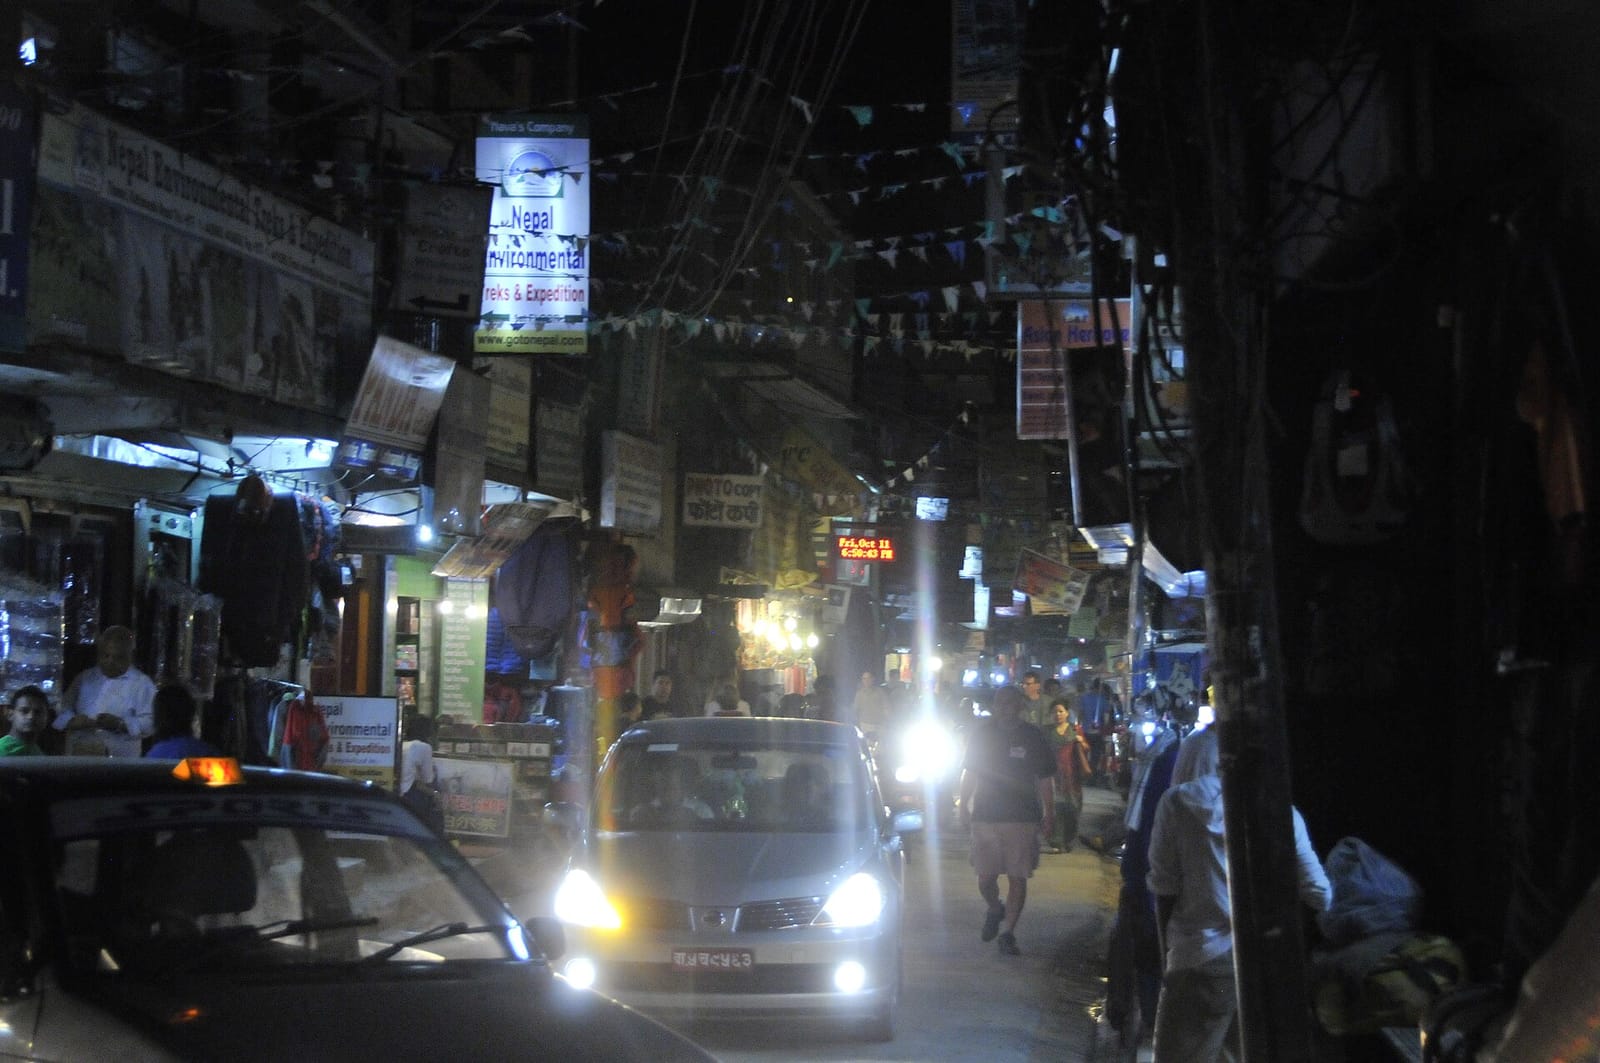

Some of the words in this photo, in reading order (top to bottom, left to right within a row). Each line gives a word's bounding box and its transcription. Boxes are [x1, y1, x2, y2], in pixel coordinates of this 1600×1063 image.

[512, 206, 553, 233] Nepal
[487, 245, 585, 269] nvironmental
[485, 284, 510, 301] reks
[514, 284, 522, 301] &
[526, 284, 585, 305] Expedition
[478, 334, 585, 347] www.gotonepal.com
[320, 702, 343, 718] epal
